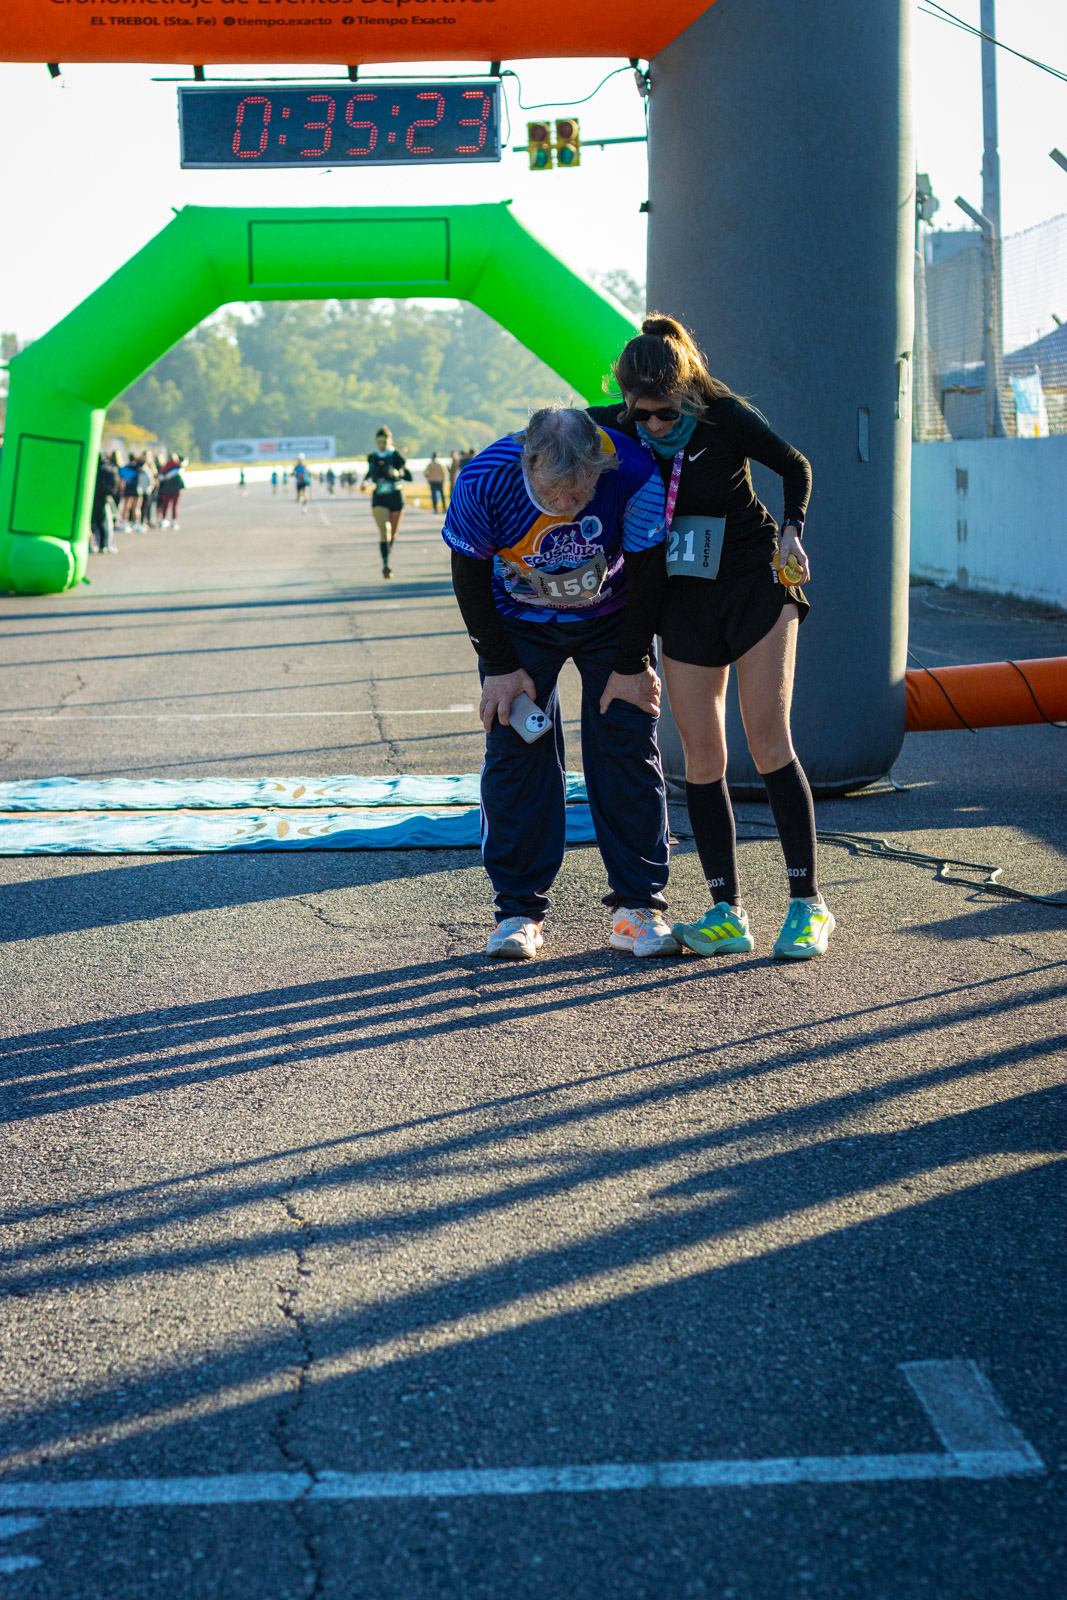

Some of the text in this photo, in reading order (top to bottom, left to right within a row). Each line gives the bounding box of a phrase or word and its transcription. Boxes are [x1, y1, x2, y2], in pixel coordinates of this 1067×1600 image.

[91, 16, 107, 26] EL
[109, 16, 161, 26] TREBOL
[237, 17, 333, 28] tiempo.exacto
[357, 16, 457, 27] Tiempo Exacto
[232, 91, 491, 158] 0:35:23
[584, 522, 594, 534] 4
[703, 529, 712, 568] EXACTO
[547, 570, 597, 597] 156
